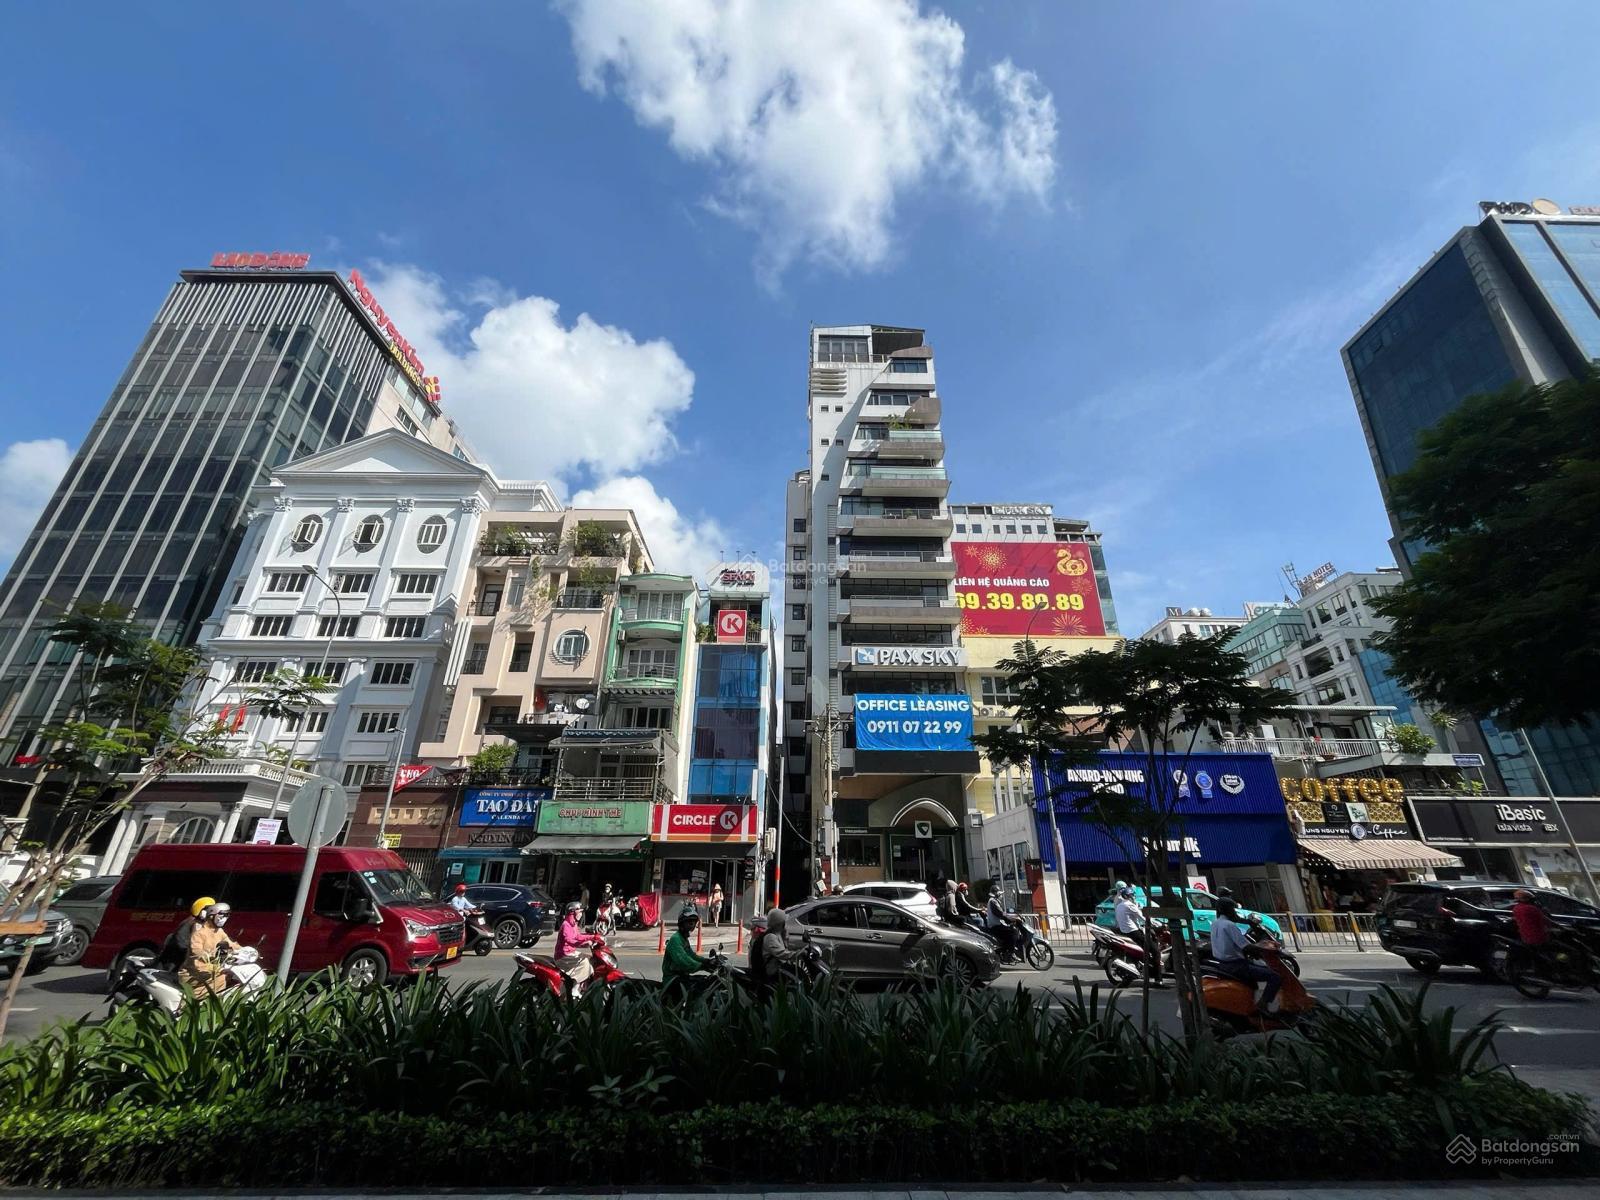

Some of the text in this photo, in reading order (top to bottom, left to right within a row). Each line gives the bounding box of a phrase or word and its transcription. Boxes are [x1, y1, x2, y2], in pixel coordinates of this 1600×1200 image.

[954, 576, 1050, 588] LIÊN HỆ QUẢNG CÁO
[857, 700, 970, 712] OFFICE LEASING
[867, 721, 962, 734] 0911 07 22 99
[477, 799, 509, 813] TAO
[1496, 804, 1547, 821] iBasic
[672, 814, 717, 826] CIRCLE
